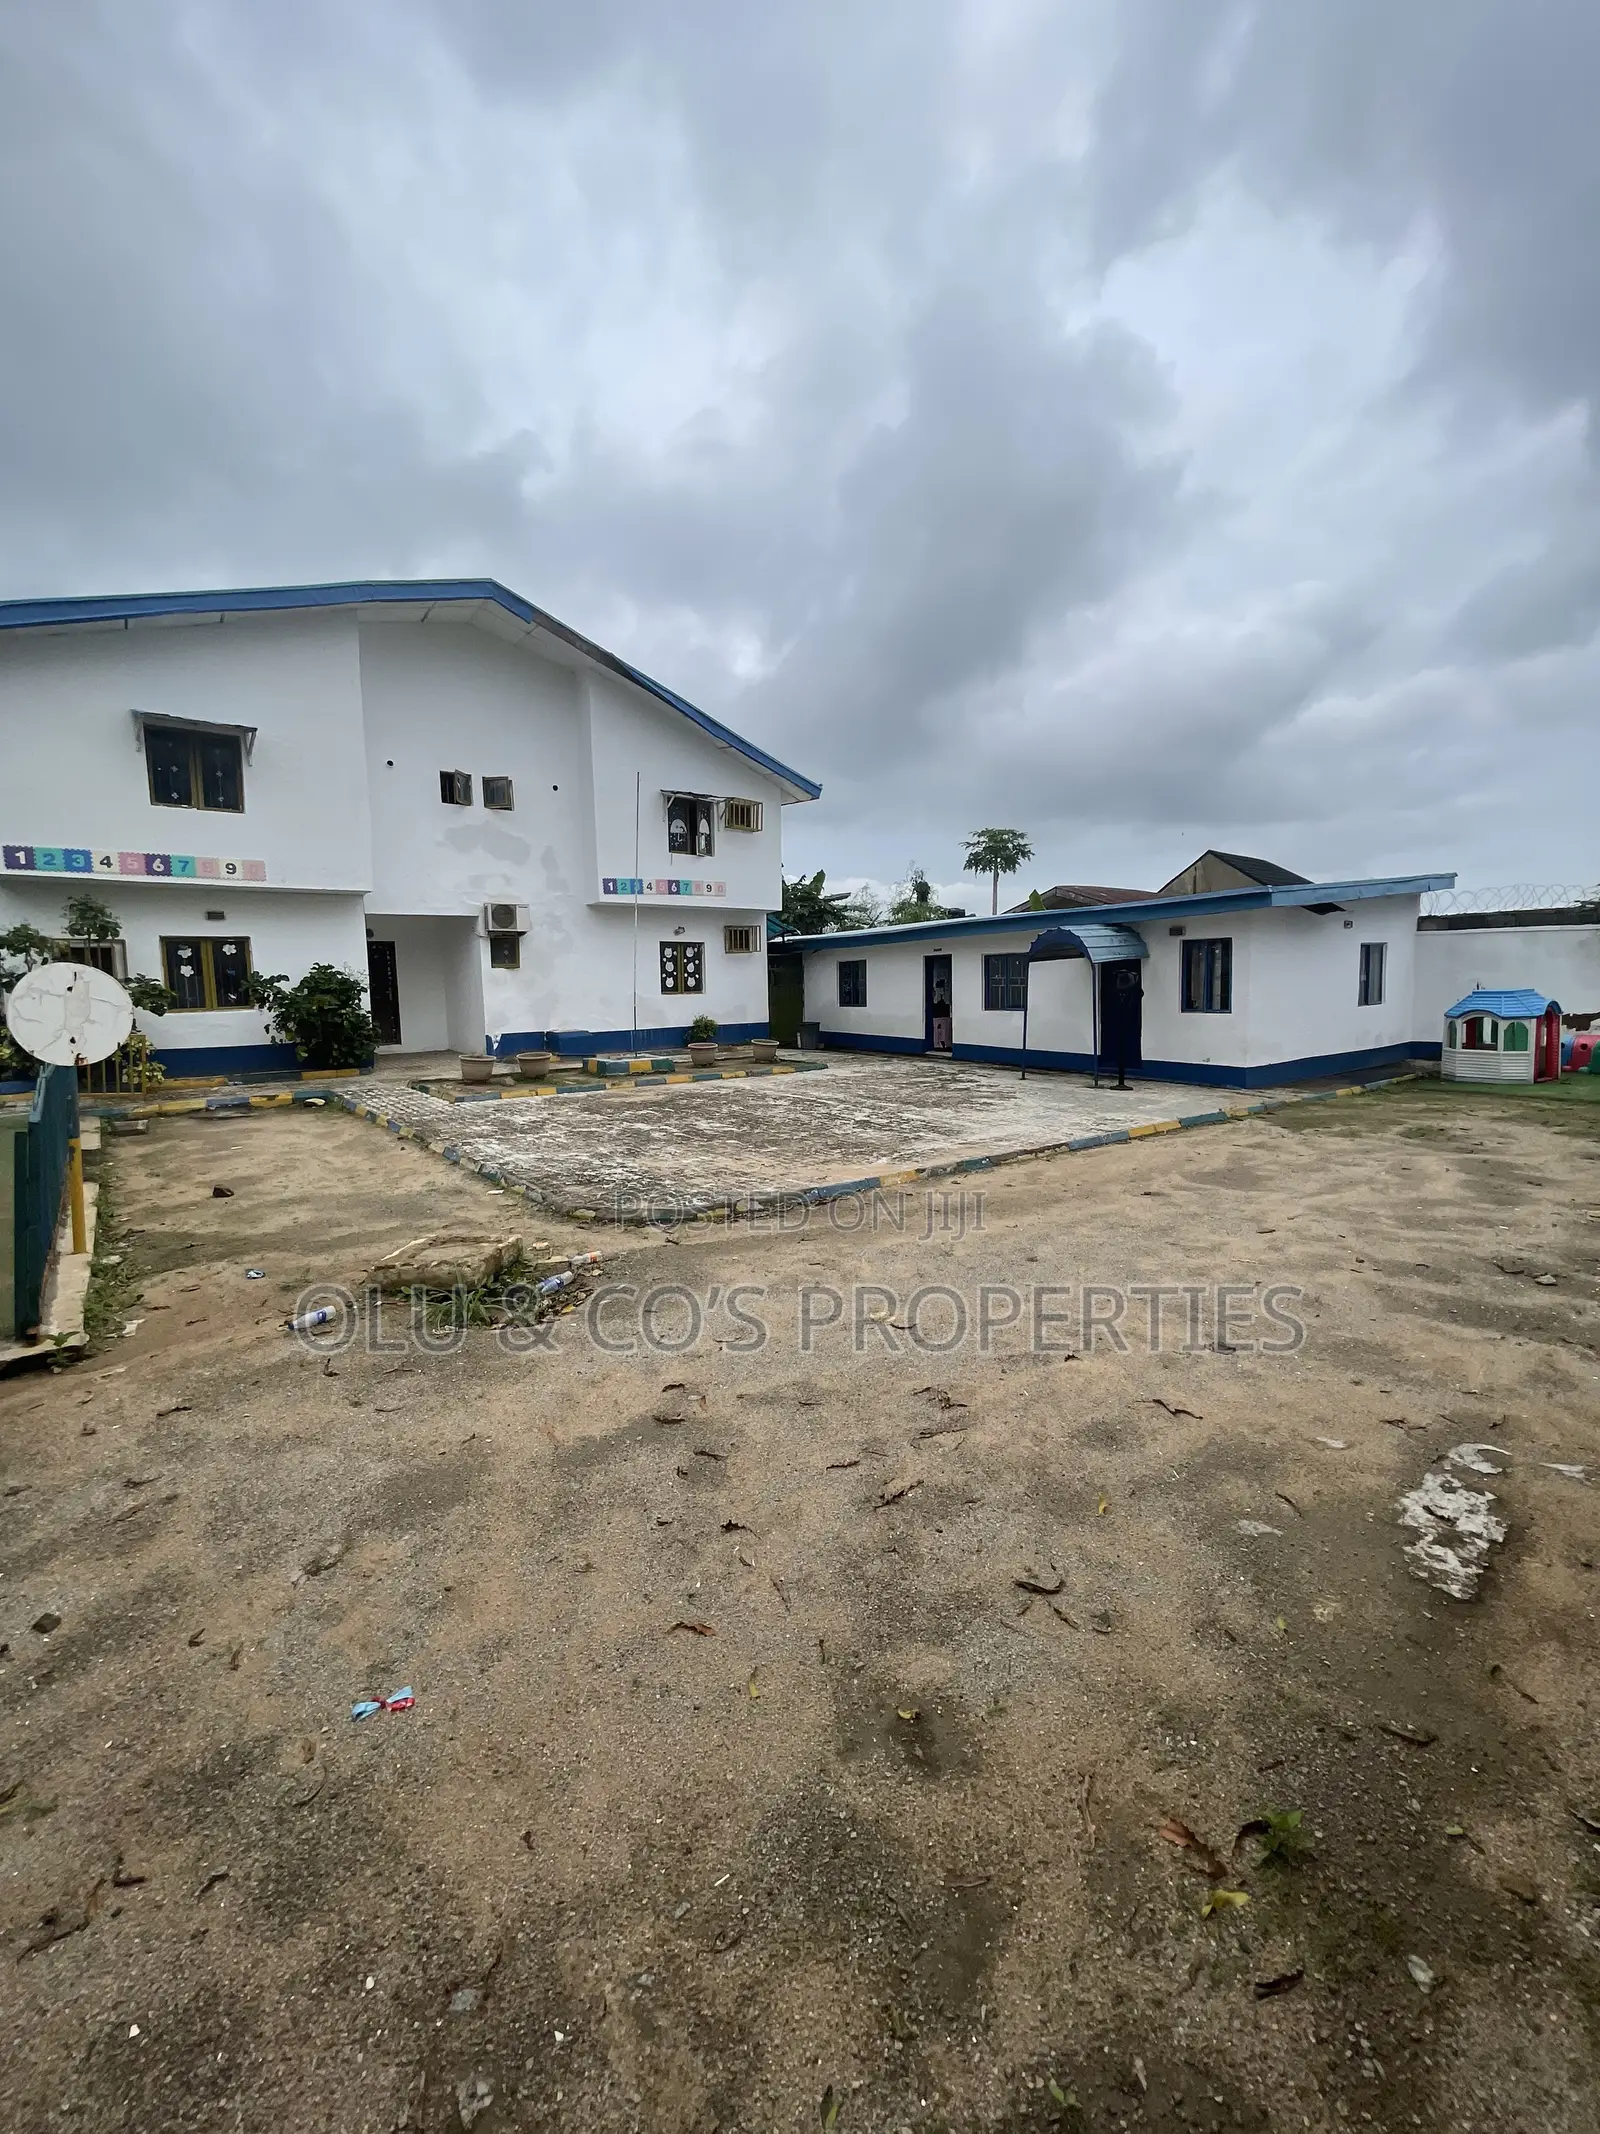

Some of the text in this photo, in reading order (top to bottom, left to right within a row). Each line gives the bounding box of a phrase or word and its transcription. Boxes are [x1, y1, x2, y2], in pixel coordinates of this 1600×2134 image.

[15, 850, 27, 865] 1
[43, 852, 57, 866] 2
[71, 854, 85, 868] 3
[99, 855, 114, 869] 4
[152, 858, 165, 872] 6
[177, 860, 190, 872] 7
[225, 862, 237, 875] 9
[646, 882, 653, 891] 4
[671, 882, 678, 892] 6
